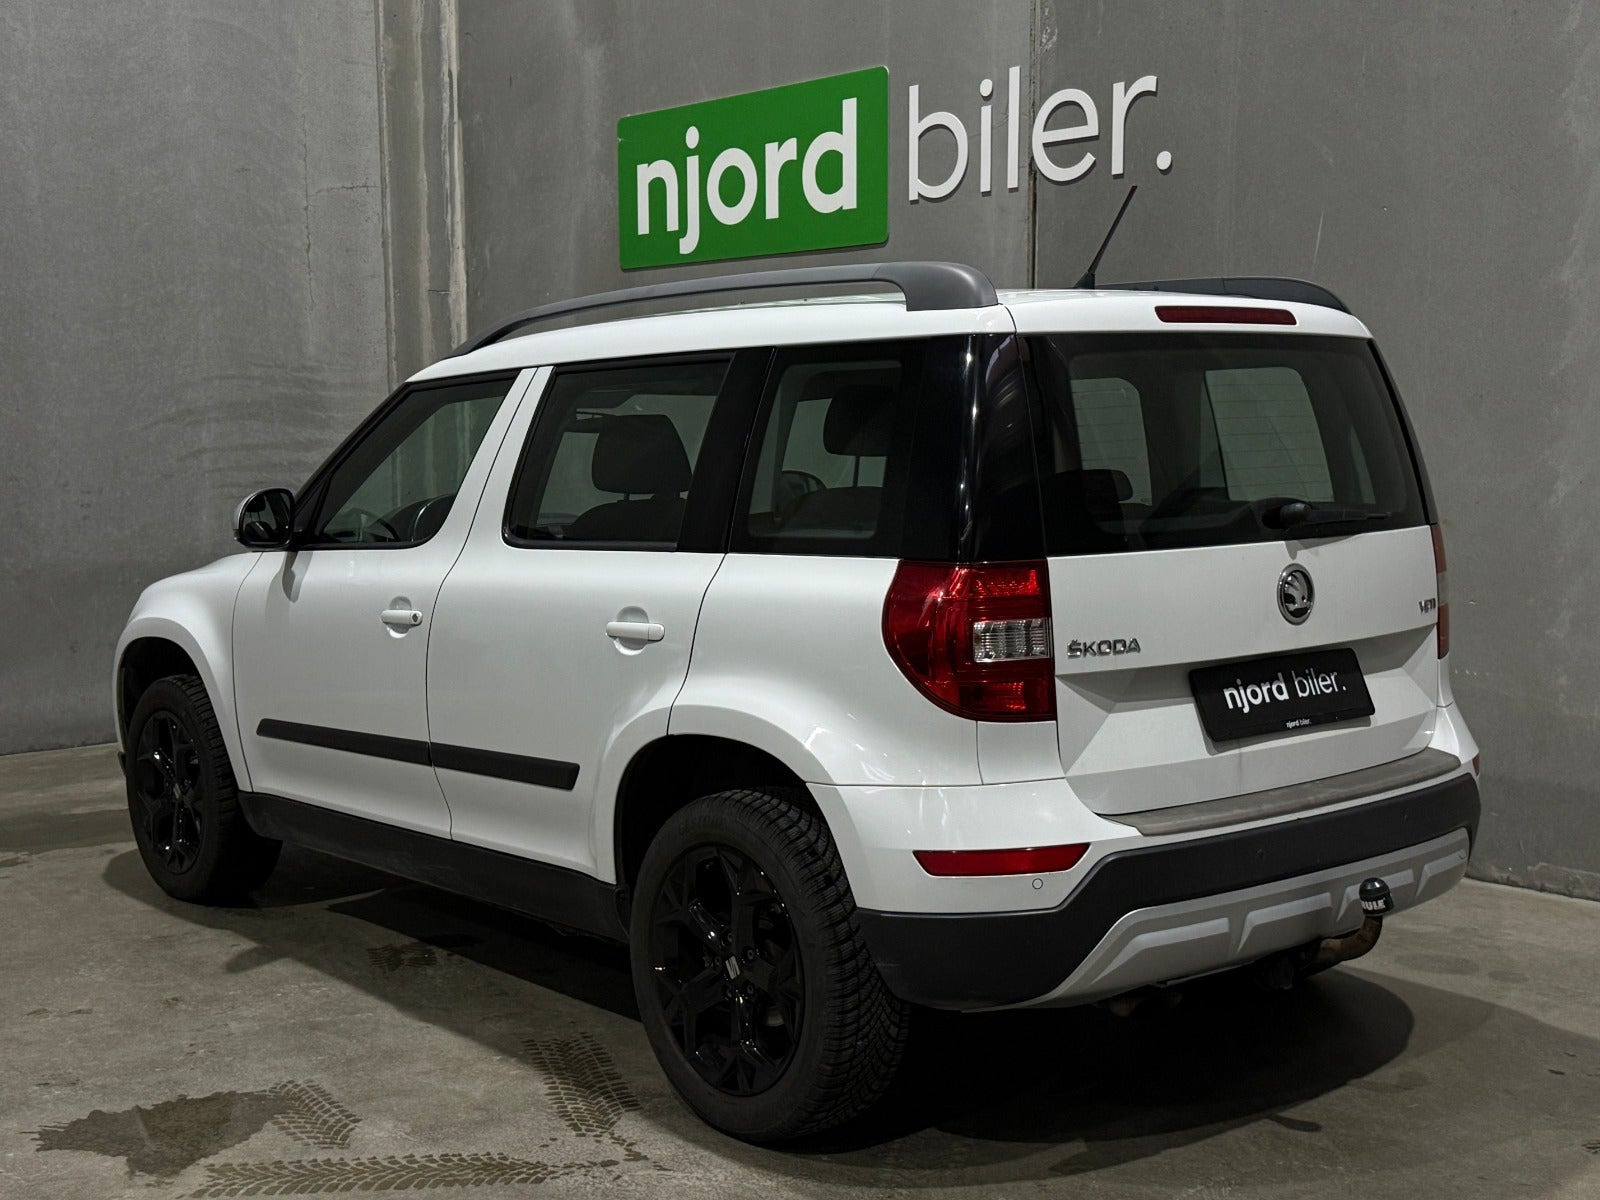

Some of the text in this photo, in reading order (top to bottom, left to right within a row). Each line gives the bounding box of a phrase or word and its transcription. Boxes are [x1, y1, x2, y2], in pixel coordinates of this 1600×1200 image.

[636, 65, 1173, 254] njord biler.
[1067, 638, 1141, 659] ŠKODA
[1223, 667, 1347, 714] njord biler.
